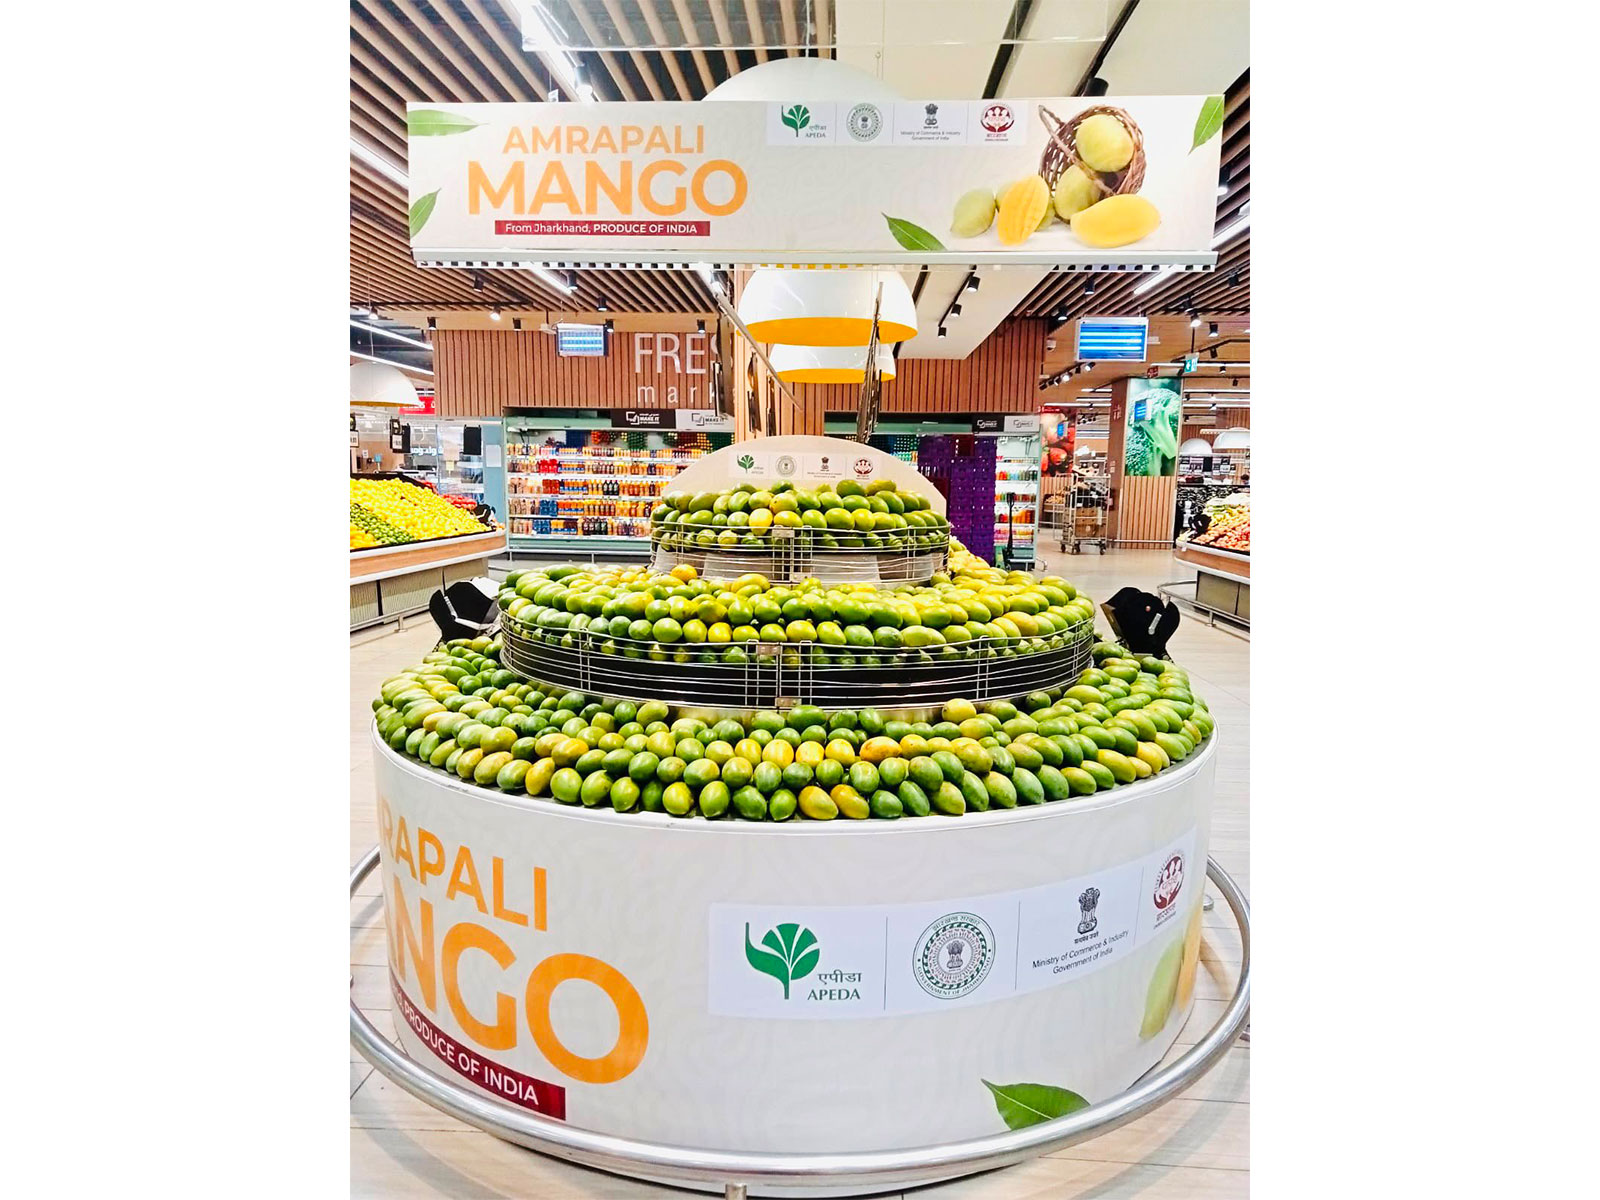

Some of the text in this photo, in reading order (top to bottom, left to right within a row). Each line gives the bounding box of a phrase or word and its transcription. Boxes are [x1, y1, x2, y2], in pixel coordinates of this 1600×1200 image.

[502, 125, 704, 154] AMRAPALI
[468, 159, 748, 216] MANGO
[506, 224, 697, 234] From Jharkhand, PRODUCE OF INDIA
[1032, 956, 1060, 968] Ministry
[1060, 952, 1068, 961] of
[1068, 942, 1101, 958] Commerce
[1108, 930, 1129, 944] Industry
[1053, 946, 1113, 974] Government of India
[387, 873, 648, 1084] NGO
[818, 969, 862, 985] एपीडा
[808, 988, 860, 1000] APEDA
[404, 1000, 539, 1106] PRODUCE OF INDIA
